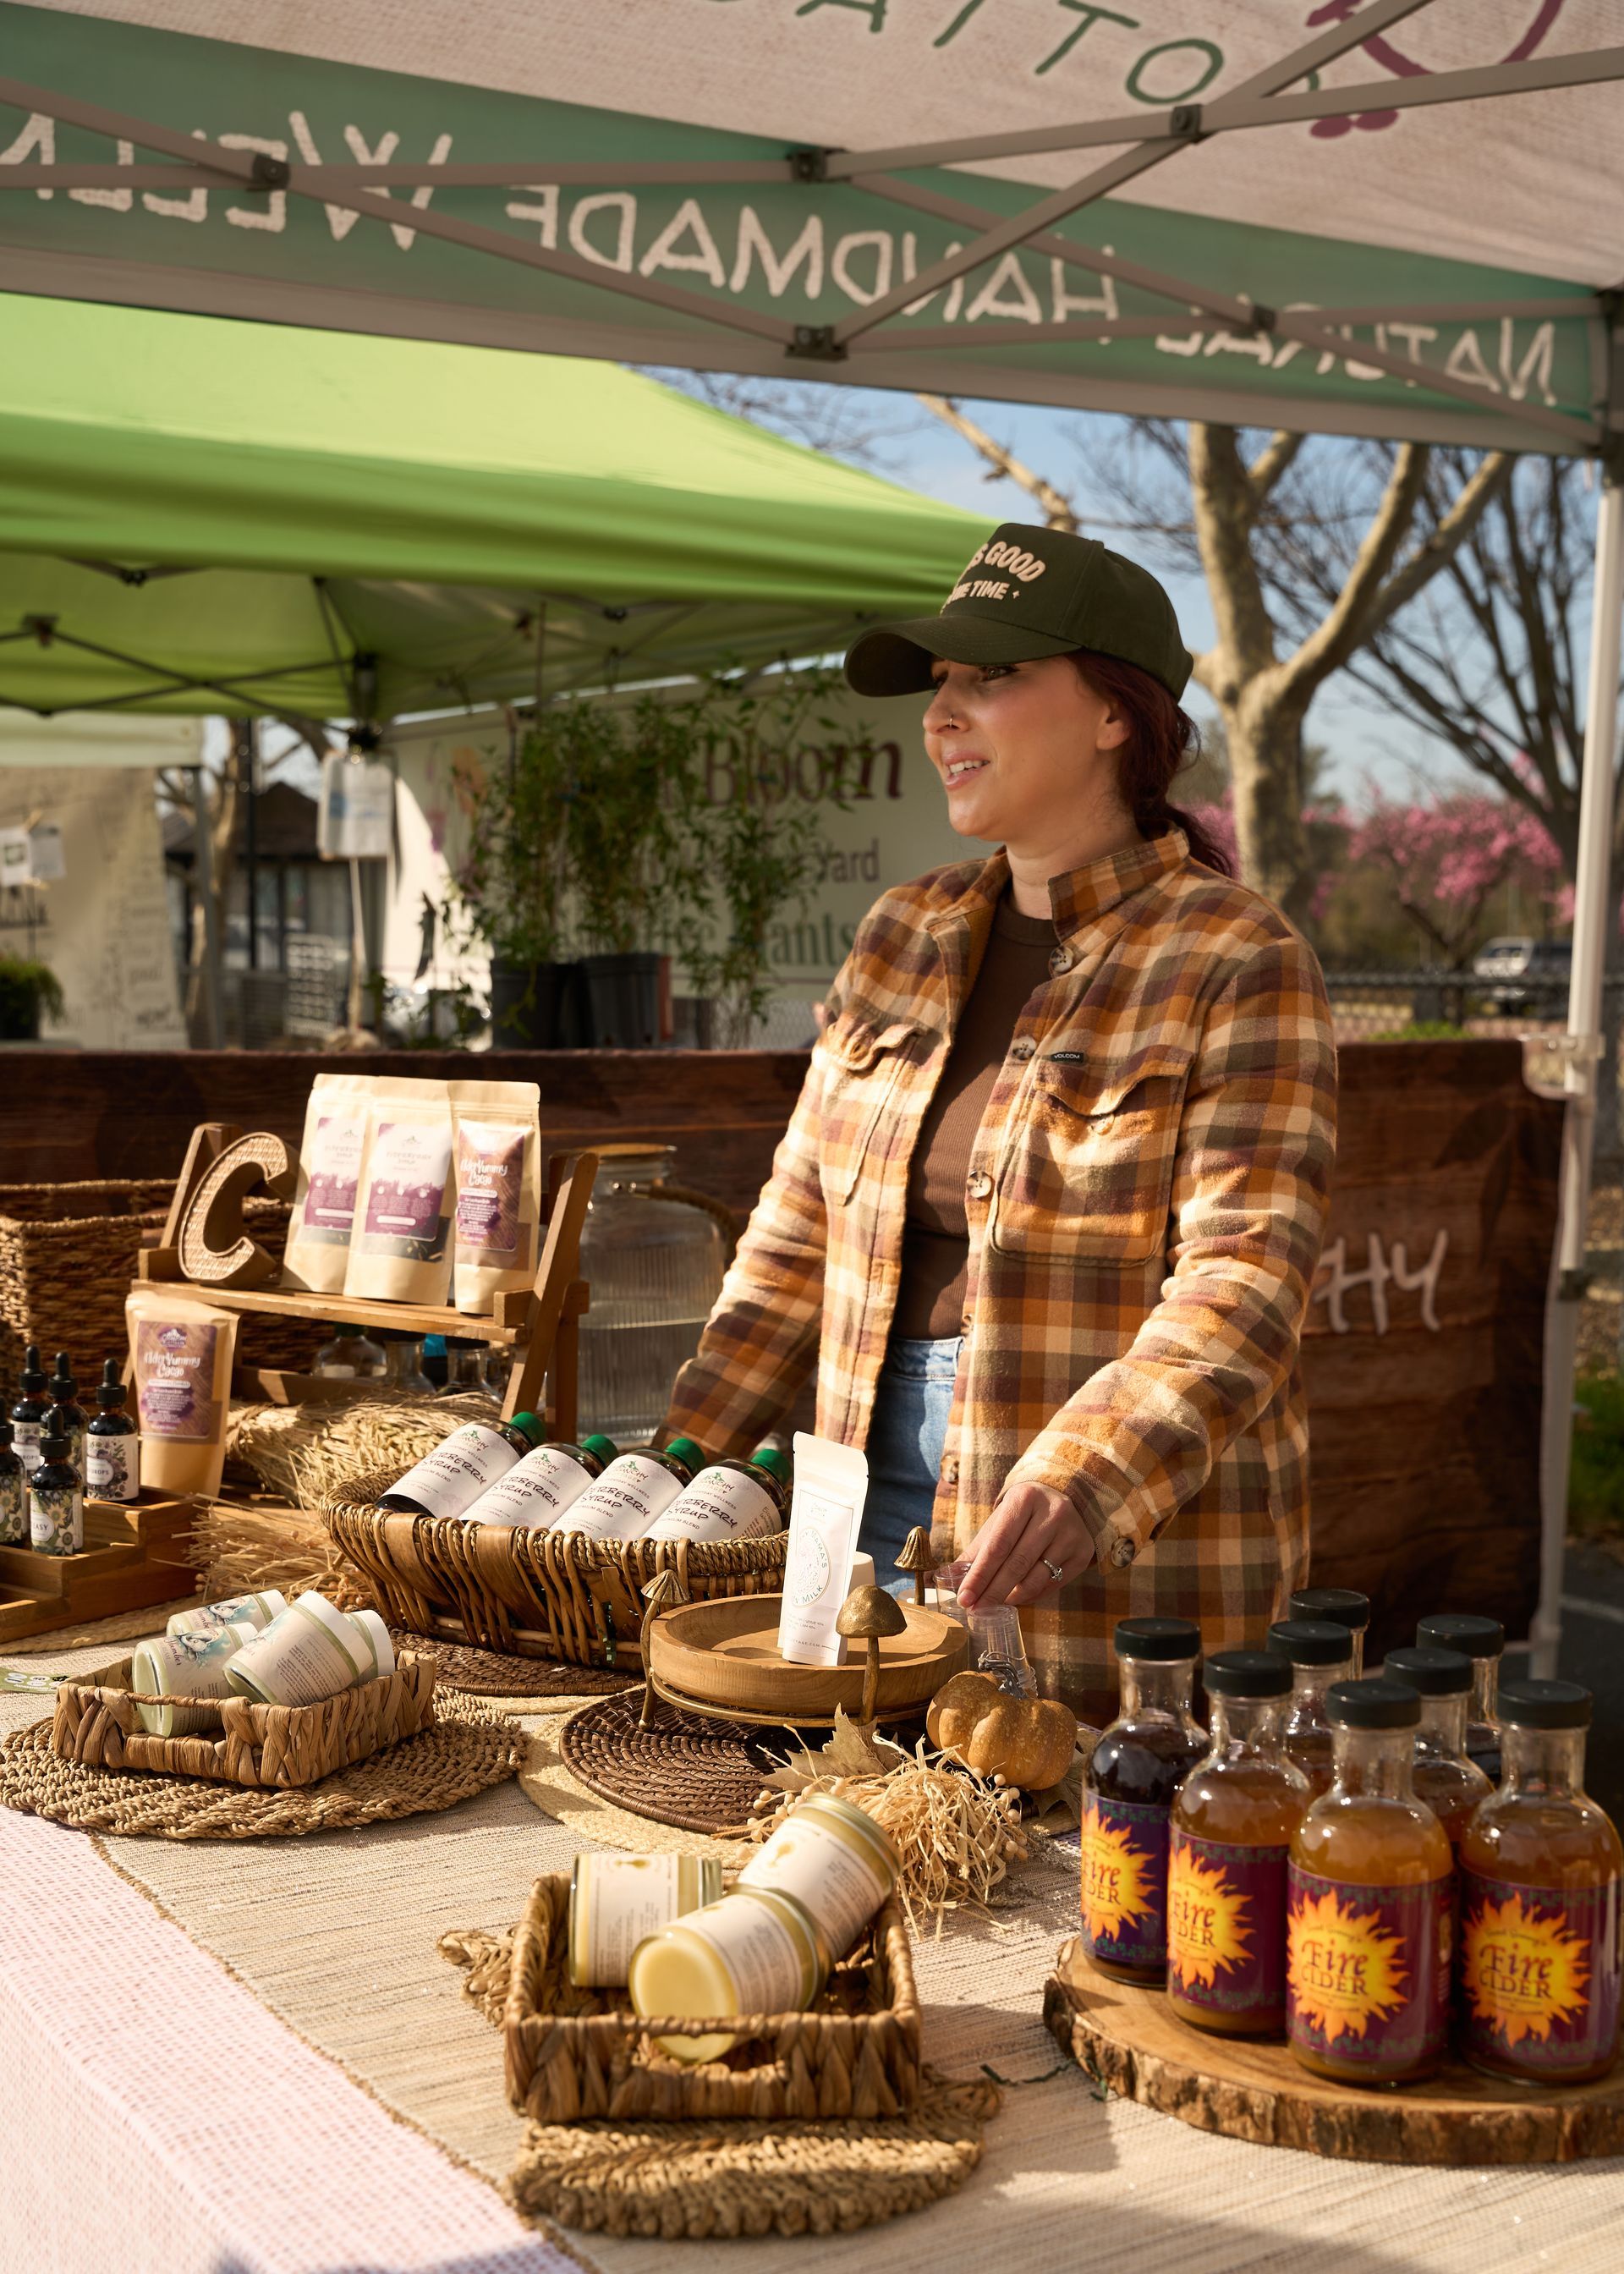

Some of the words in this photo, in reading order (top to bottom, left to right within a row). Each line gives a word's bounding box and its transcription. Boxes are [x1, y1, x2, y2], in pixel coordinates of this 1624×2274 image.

[985, 541, 1045, 582] GOOD
[969, 580, 1010, 600] TIME
[801, 1585, 823, 1604] MILK
[1301, 1938, 1369, 1976] Fire
[1479, 1942, 1554, 1980] Fire
[1301, 1963, 1370, 1996] CIDER
[1478, 1968, 1555, 2000] CIDER
